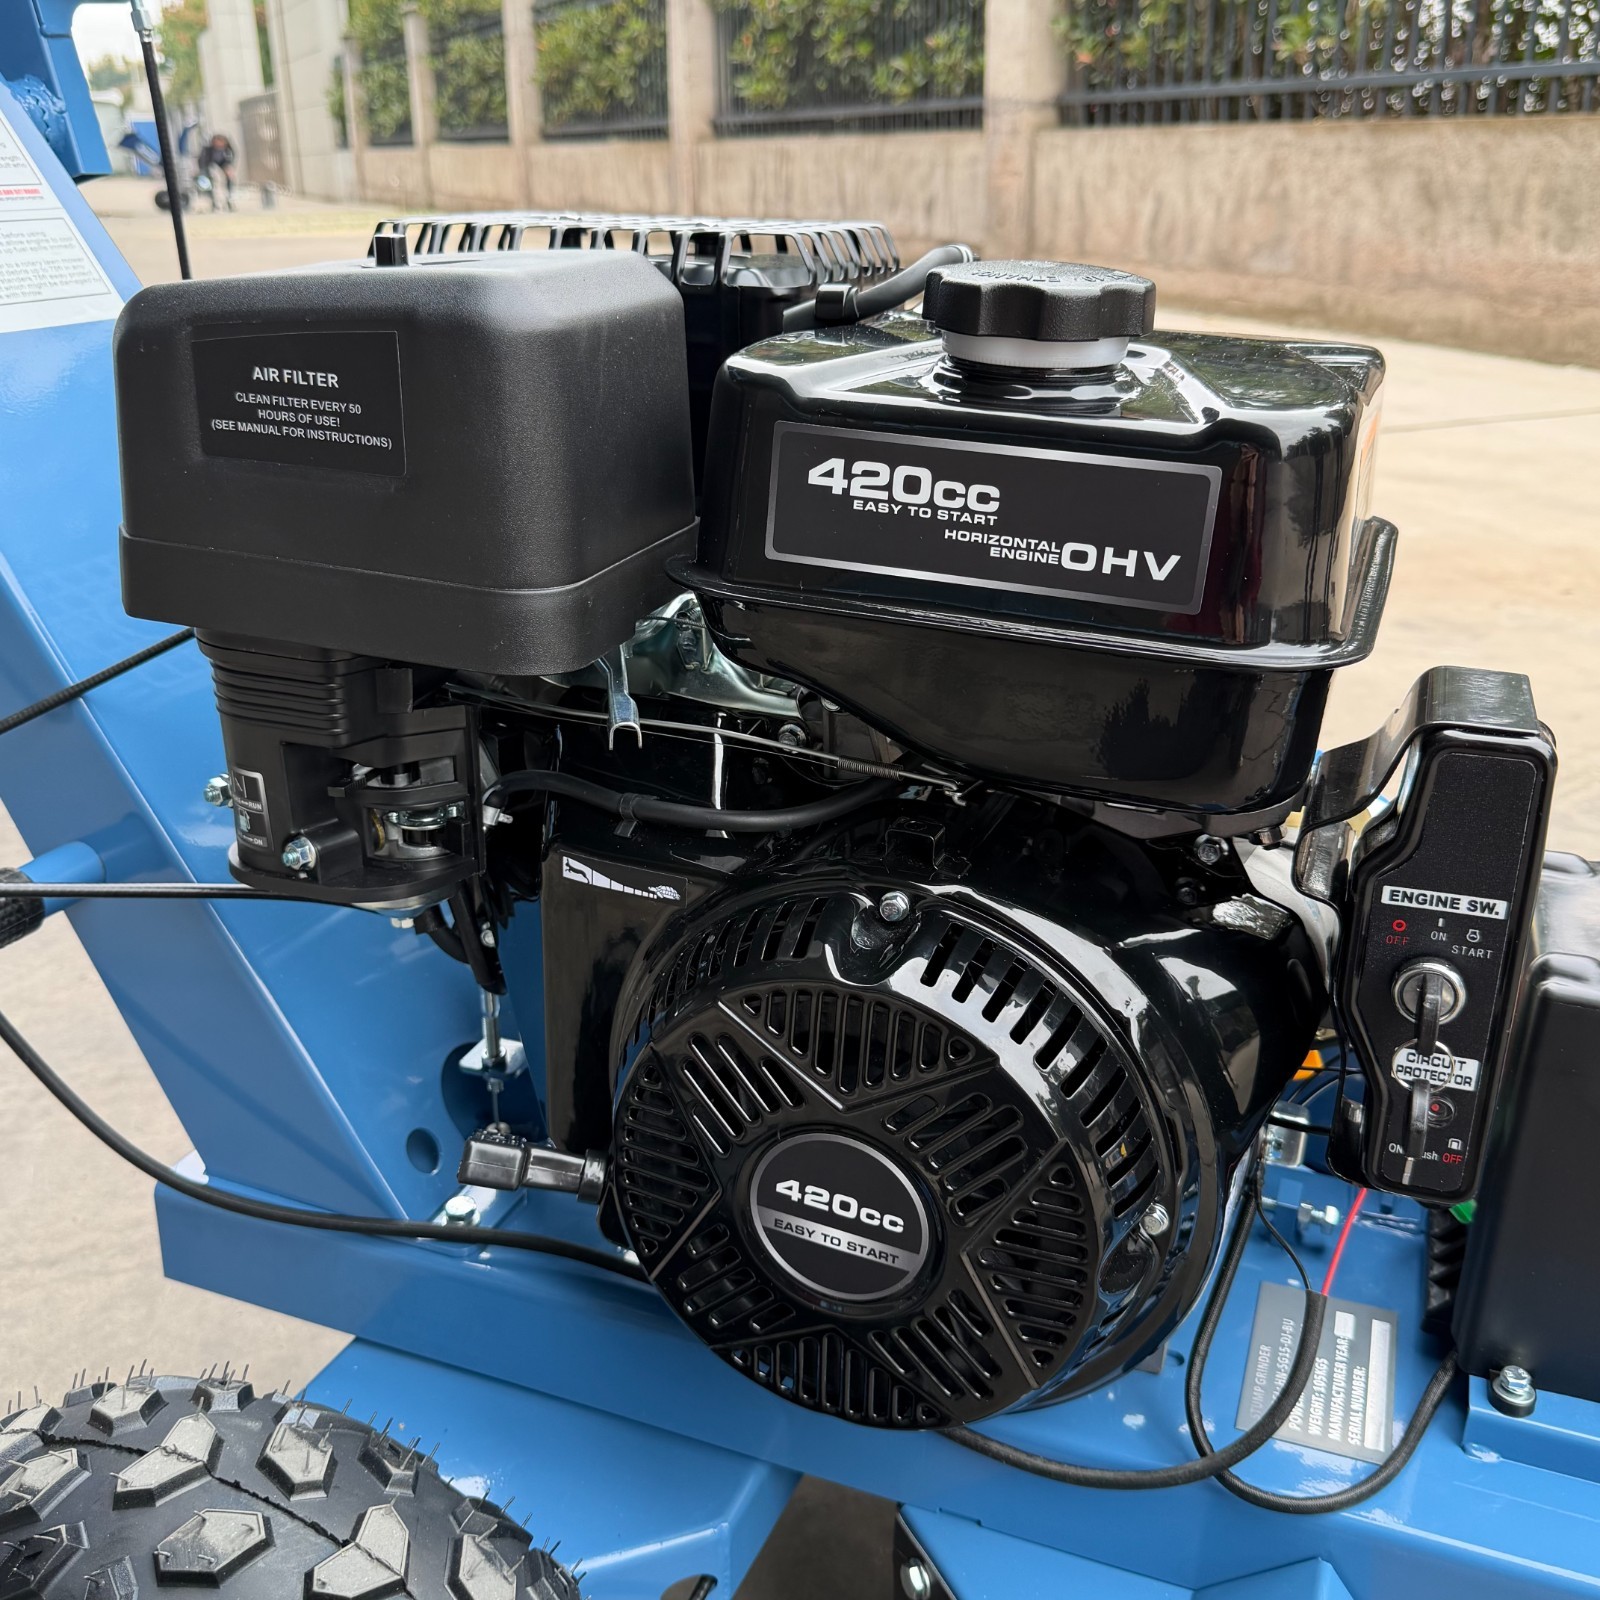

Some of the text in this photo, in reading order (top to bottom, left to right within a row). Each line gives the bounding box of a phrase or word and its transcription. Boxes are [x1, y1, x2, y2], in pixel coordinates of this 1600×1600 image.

[253, 366, 339, 388] AIR FILTER
[235, 392, 361, 414] CLEAN FILTER EVERY 50
[258, 409, 340, 427] HOURS OF USE!
[211, 419, 393, 450] (SEE MANUAL FOR INSTRUCTIONS)
[808, 458, 1000, 512] 420cc
[853, 500, 998, 526] EASY TO START
[944, 529, 1062, 553] HORIZONTAL
[989, 541, 1181, 581] ENGINE OHV
[1388, 889, 1500, 916] ENGINE SW.
[1385, 935, 1409, 946] OFF
[1430, 931, 1447, 941] ON
[1451, 944, 1493, 959] START
[1406, 1051, 1467, 1071] CIRCUT
[1388, 1142, 1405, 1155] ON
[1442, 1152, 1463, 1164] OFF
[775, 1179, 905, 1233] 420cc
[774, 1218, 900, 1264] EASY TO START
[1250, 1344, 1272, 1419] STUMP GRINDER
[1328, 1336, 1352, 1441] MANUFACTURER YEAR:
[1307, 1357, 1330, 1436] WEIGHT: 105KGS
[1347, 1366, 1367, 1446] SERIAL NUMBER:
